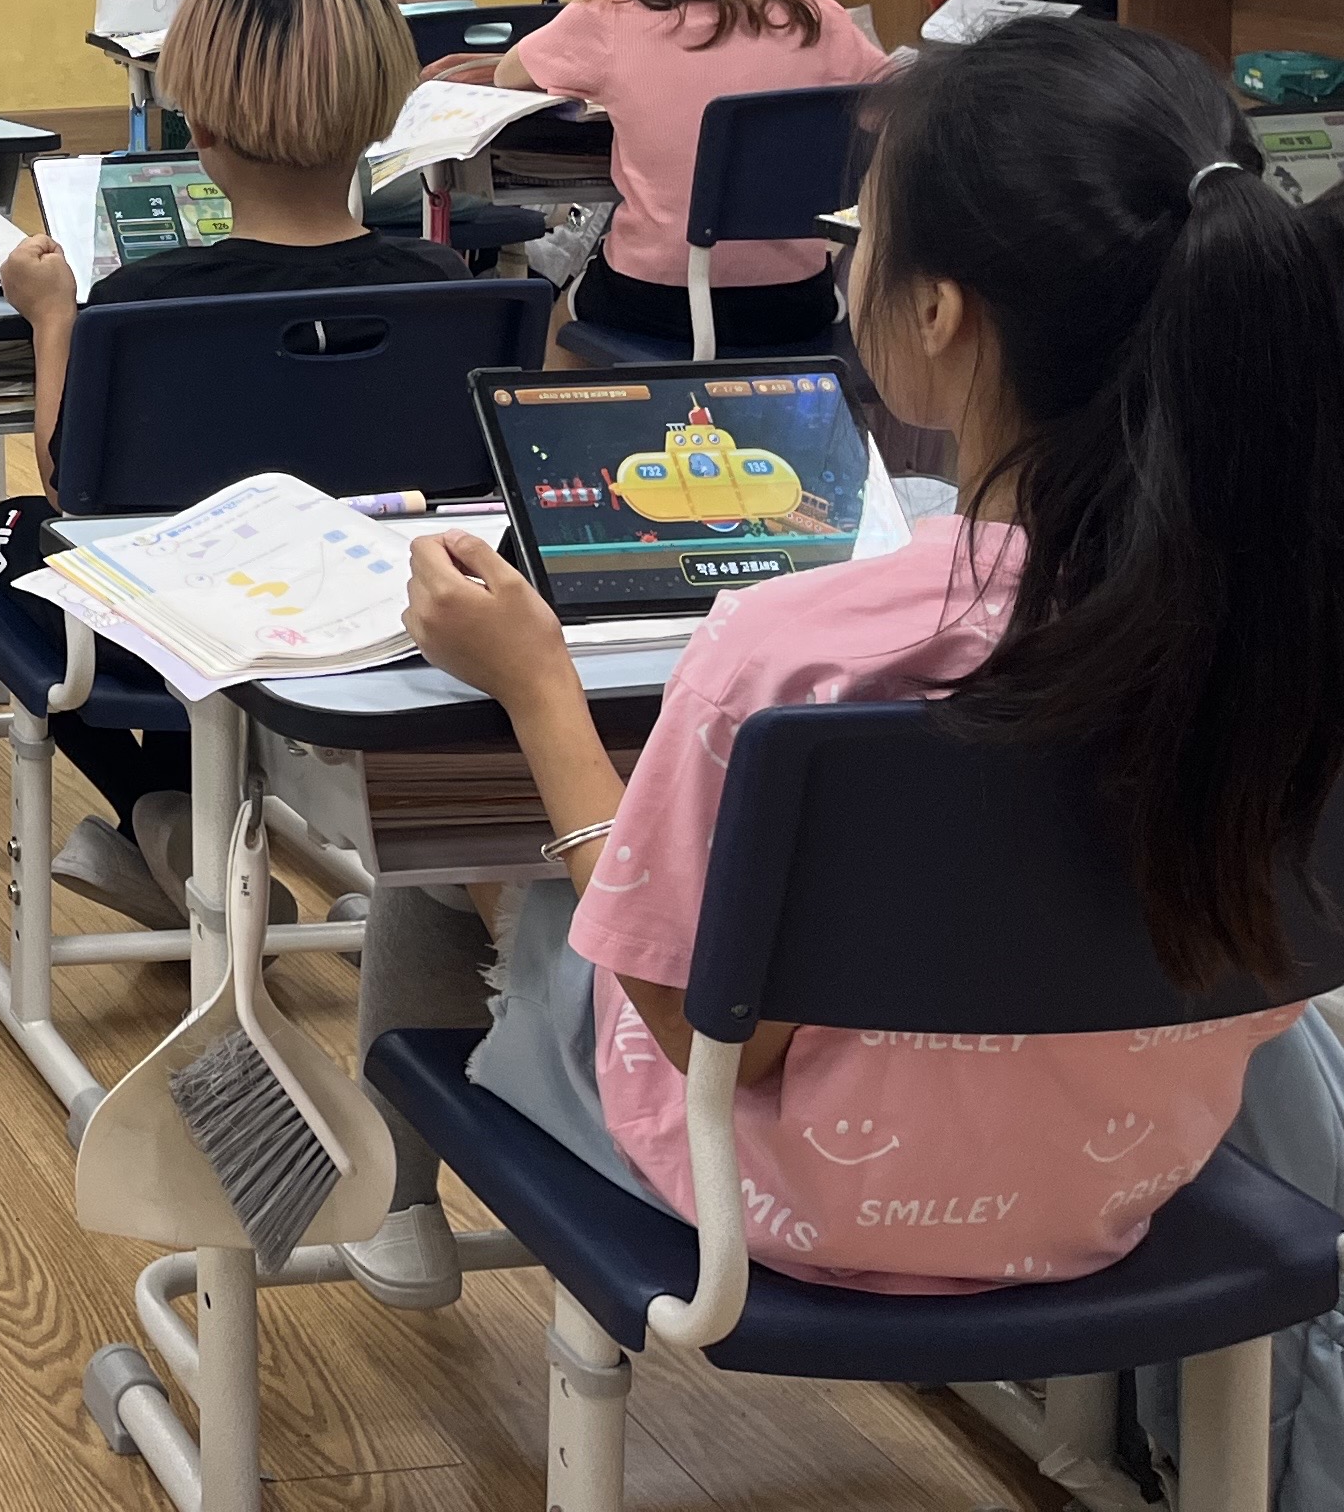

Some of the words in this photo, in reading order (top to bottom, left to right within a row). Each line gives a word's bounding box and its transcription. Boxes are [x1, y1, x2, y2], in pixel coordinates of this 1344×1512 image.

[639, 465, 663, 478] 732
[746, 461, 768, 474] 135
[695, 562, 719, 576] 작은
